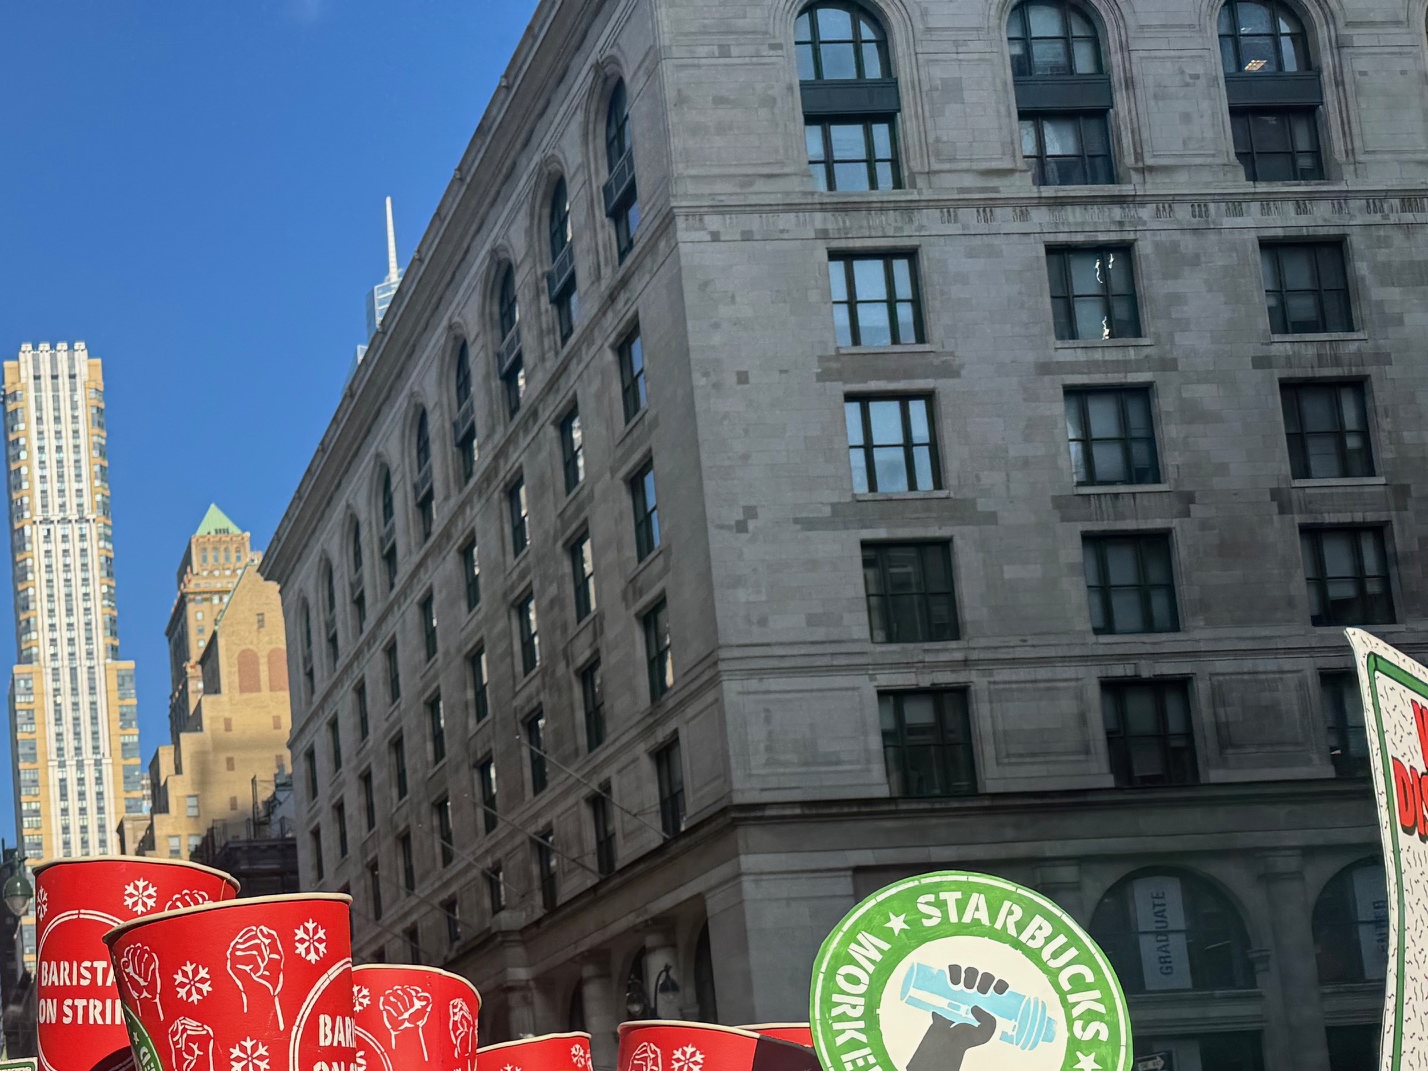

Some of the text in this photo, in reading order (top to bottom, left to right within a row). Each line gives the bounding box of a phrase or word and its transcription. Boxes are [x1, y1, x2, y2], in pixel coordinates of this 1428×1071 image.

[916, 890, 1109, 1042] STARBUCKS
[1151, 890, 1174, 976] GRADUATE
[38, 998, 58, 1024] ON
